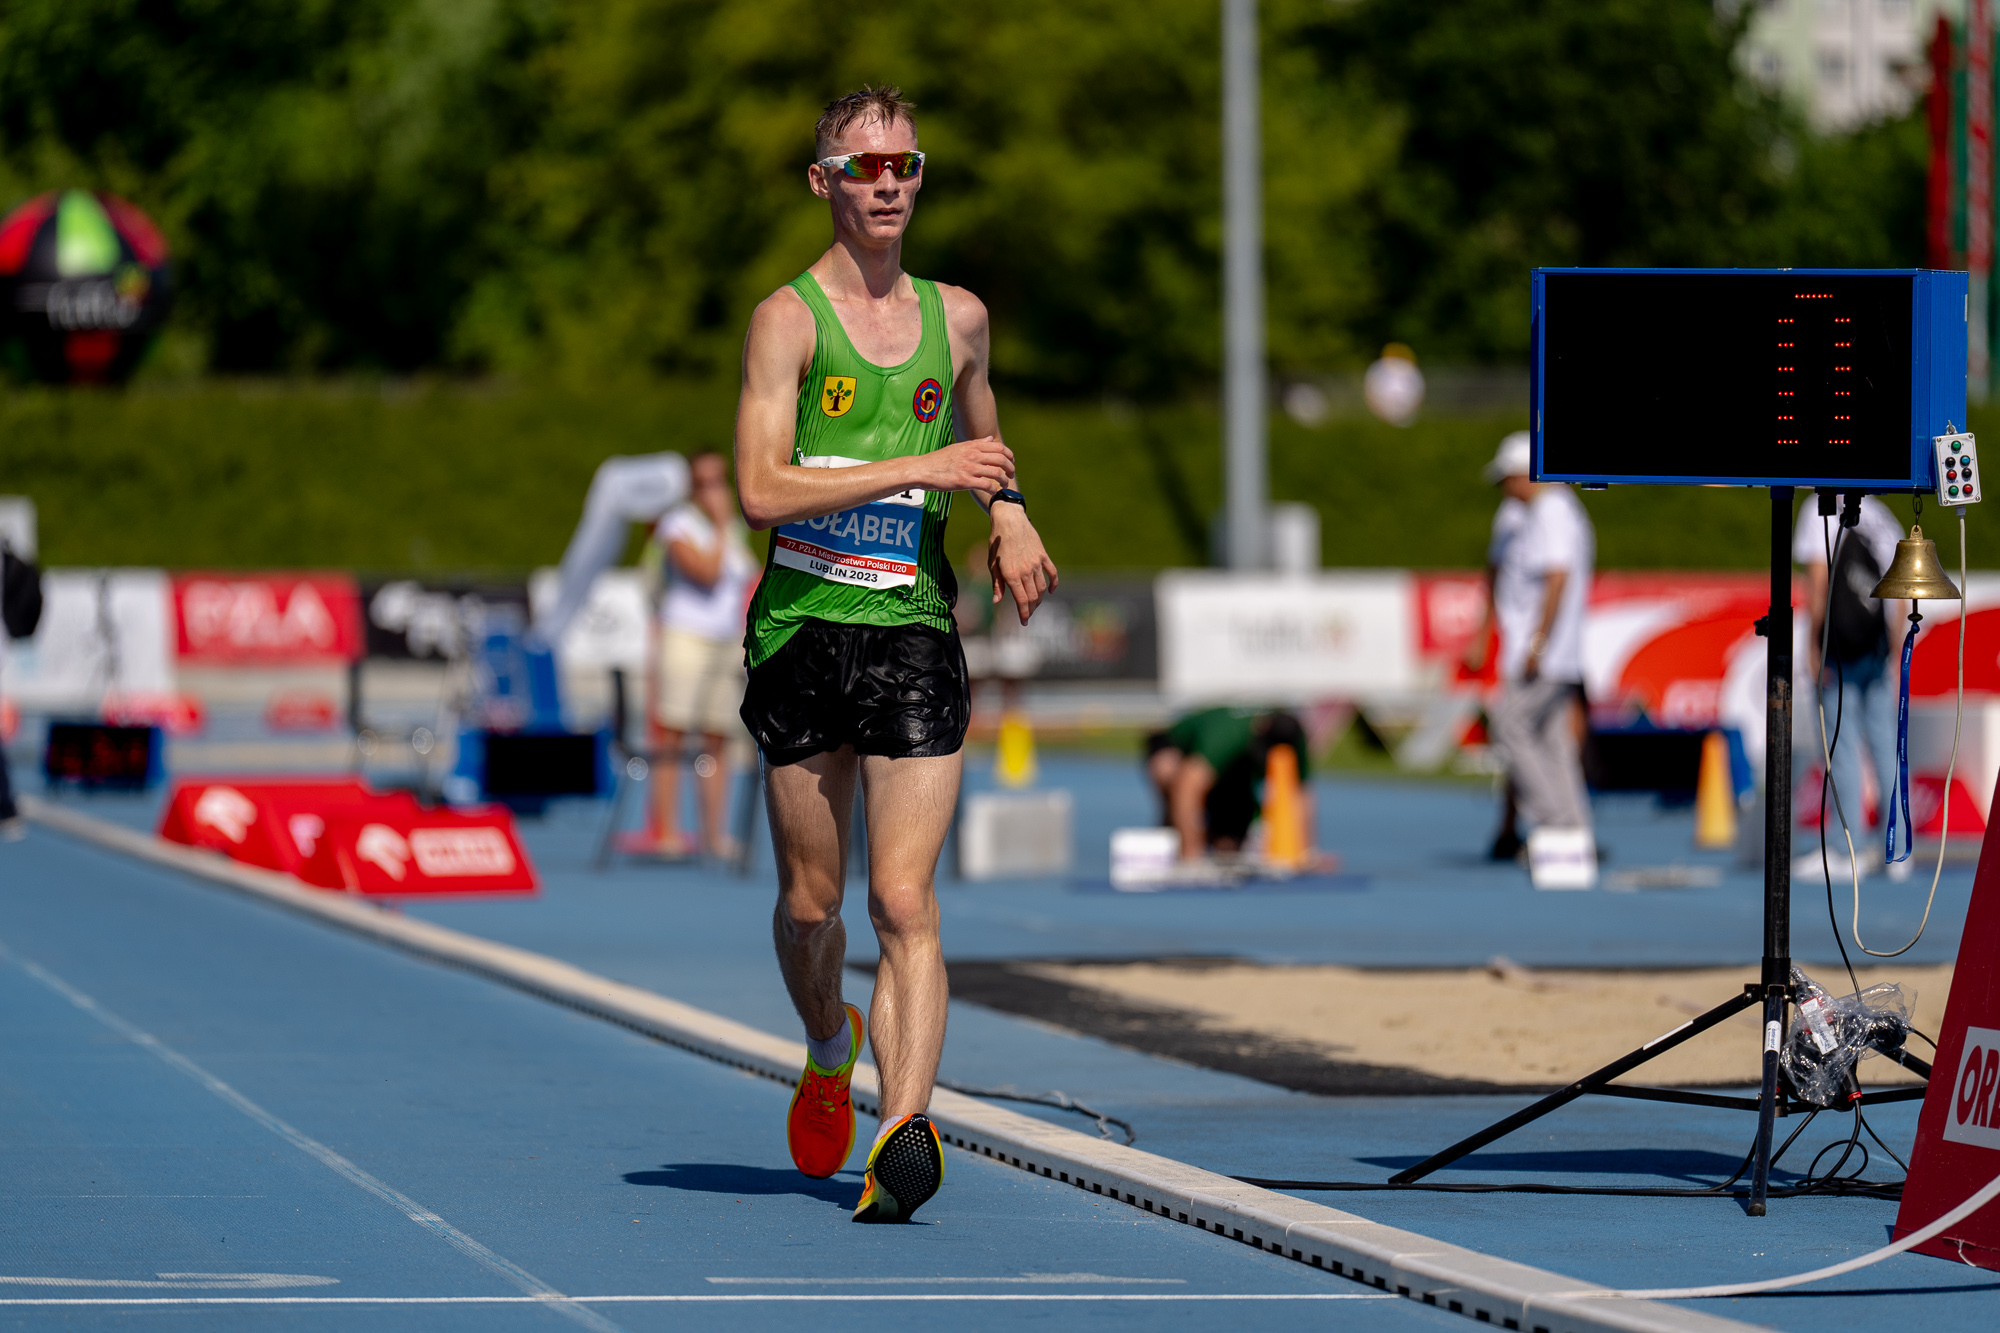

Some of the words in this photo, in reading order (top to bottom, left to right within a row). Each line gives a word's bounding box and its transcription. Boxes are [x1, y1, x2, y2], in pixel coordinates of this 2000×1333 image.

[793, 512, 916, 549] OŁĄBEK
[786, 540, 798, 550] 77.
[798, 545, 817, 556] PZLA
[818, 550, 865, 567] Mistrzostwa
[866, 560, 890, 571] Polski
[891, 563, 907, 573] U20
[809, 560, 847, 578] LUBLIN
[849, 570, 878, 583] 2023
